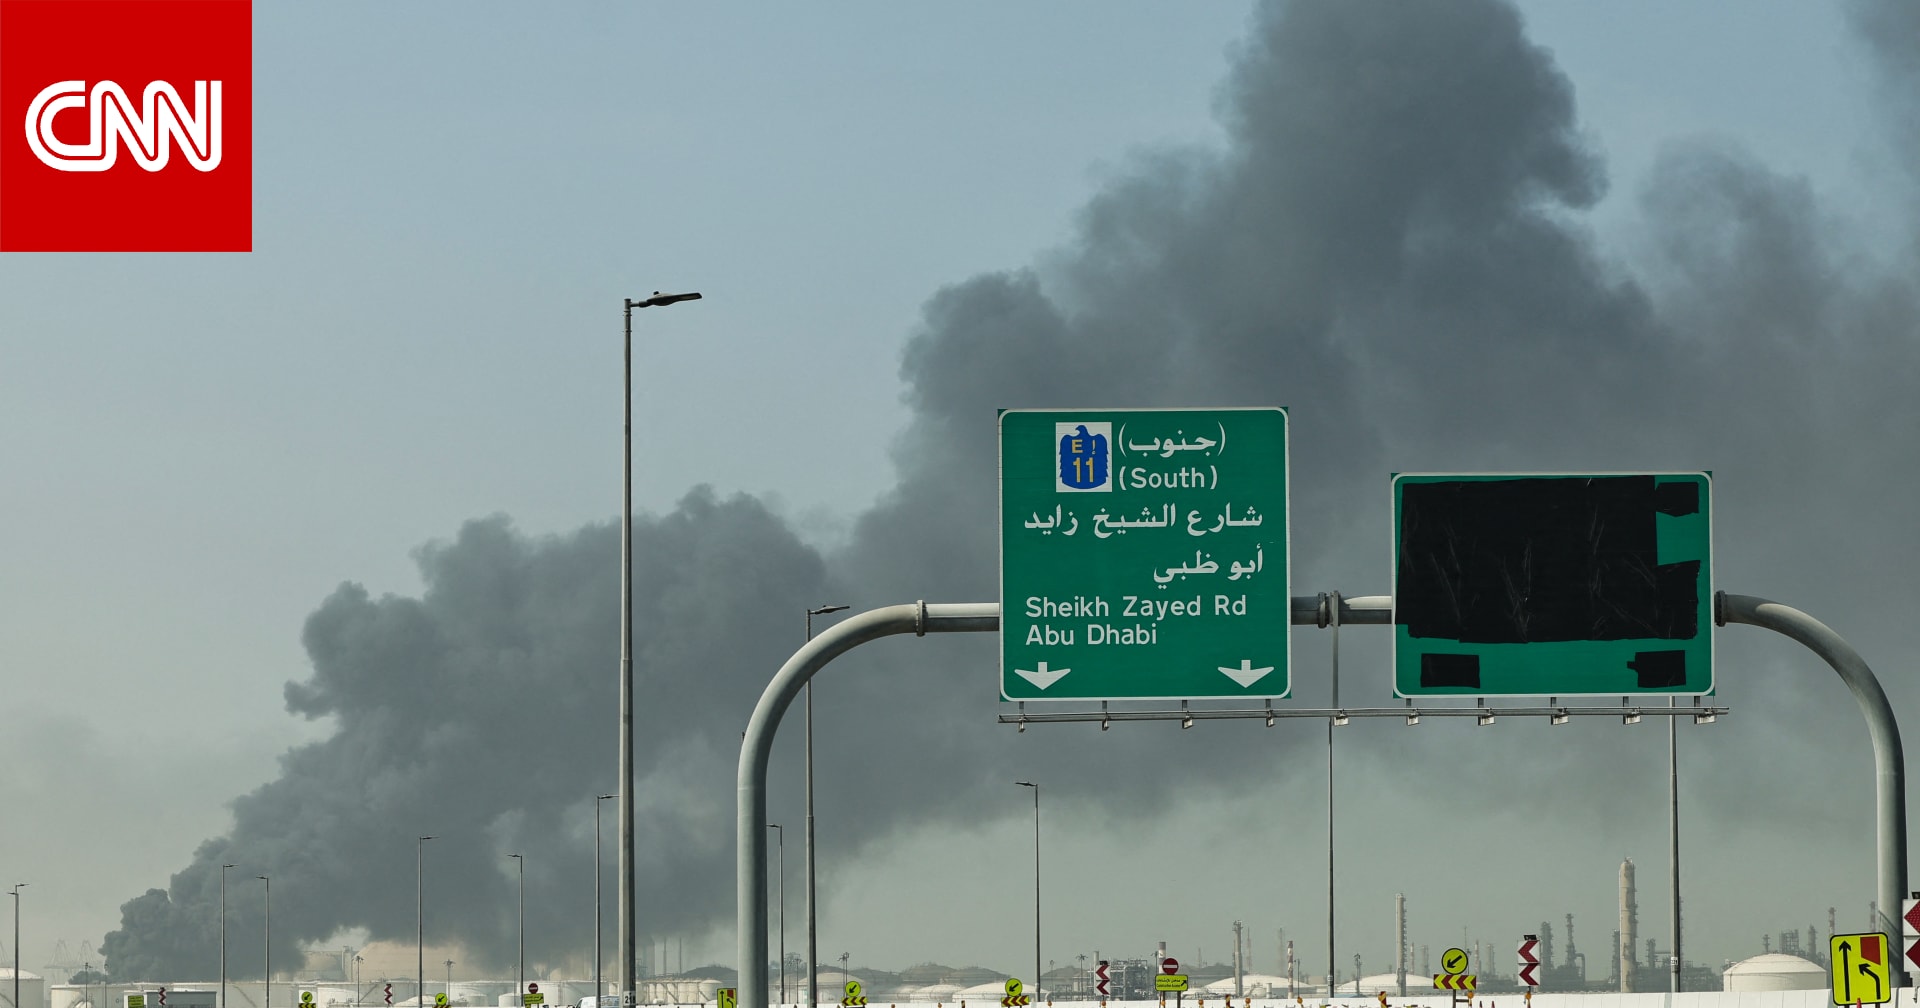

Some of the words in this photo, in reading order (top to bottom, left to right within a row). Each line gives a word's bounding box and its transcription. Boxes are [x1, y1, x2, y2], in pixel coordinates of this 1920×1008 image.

[1072, 439, 1083, 454] E
[1118, 422, 1226, 458] (جنوب)
[1073, 458, 1094, 483] 11
[1119, 466, 1218, 491] (South)
[1024, 503, 1079, 536] زايد
[1093, 503, 1176, 539] الشيخ
[1187, 502, 1263, 537] شارع
[1153, 550, 1219, 590] ظبي
[1228, 544, 1263, 581] أبو
[1025, 596, 1109, 618] Sheikh
[1122, 596, 1201, 621] Zayed
[1214, 595, 1247, 616] Rd
[1025, 624, 1074, 646] Abu
[1087, 623, 1157, 645] Dhabi
